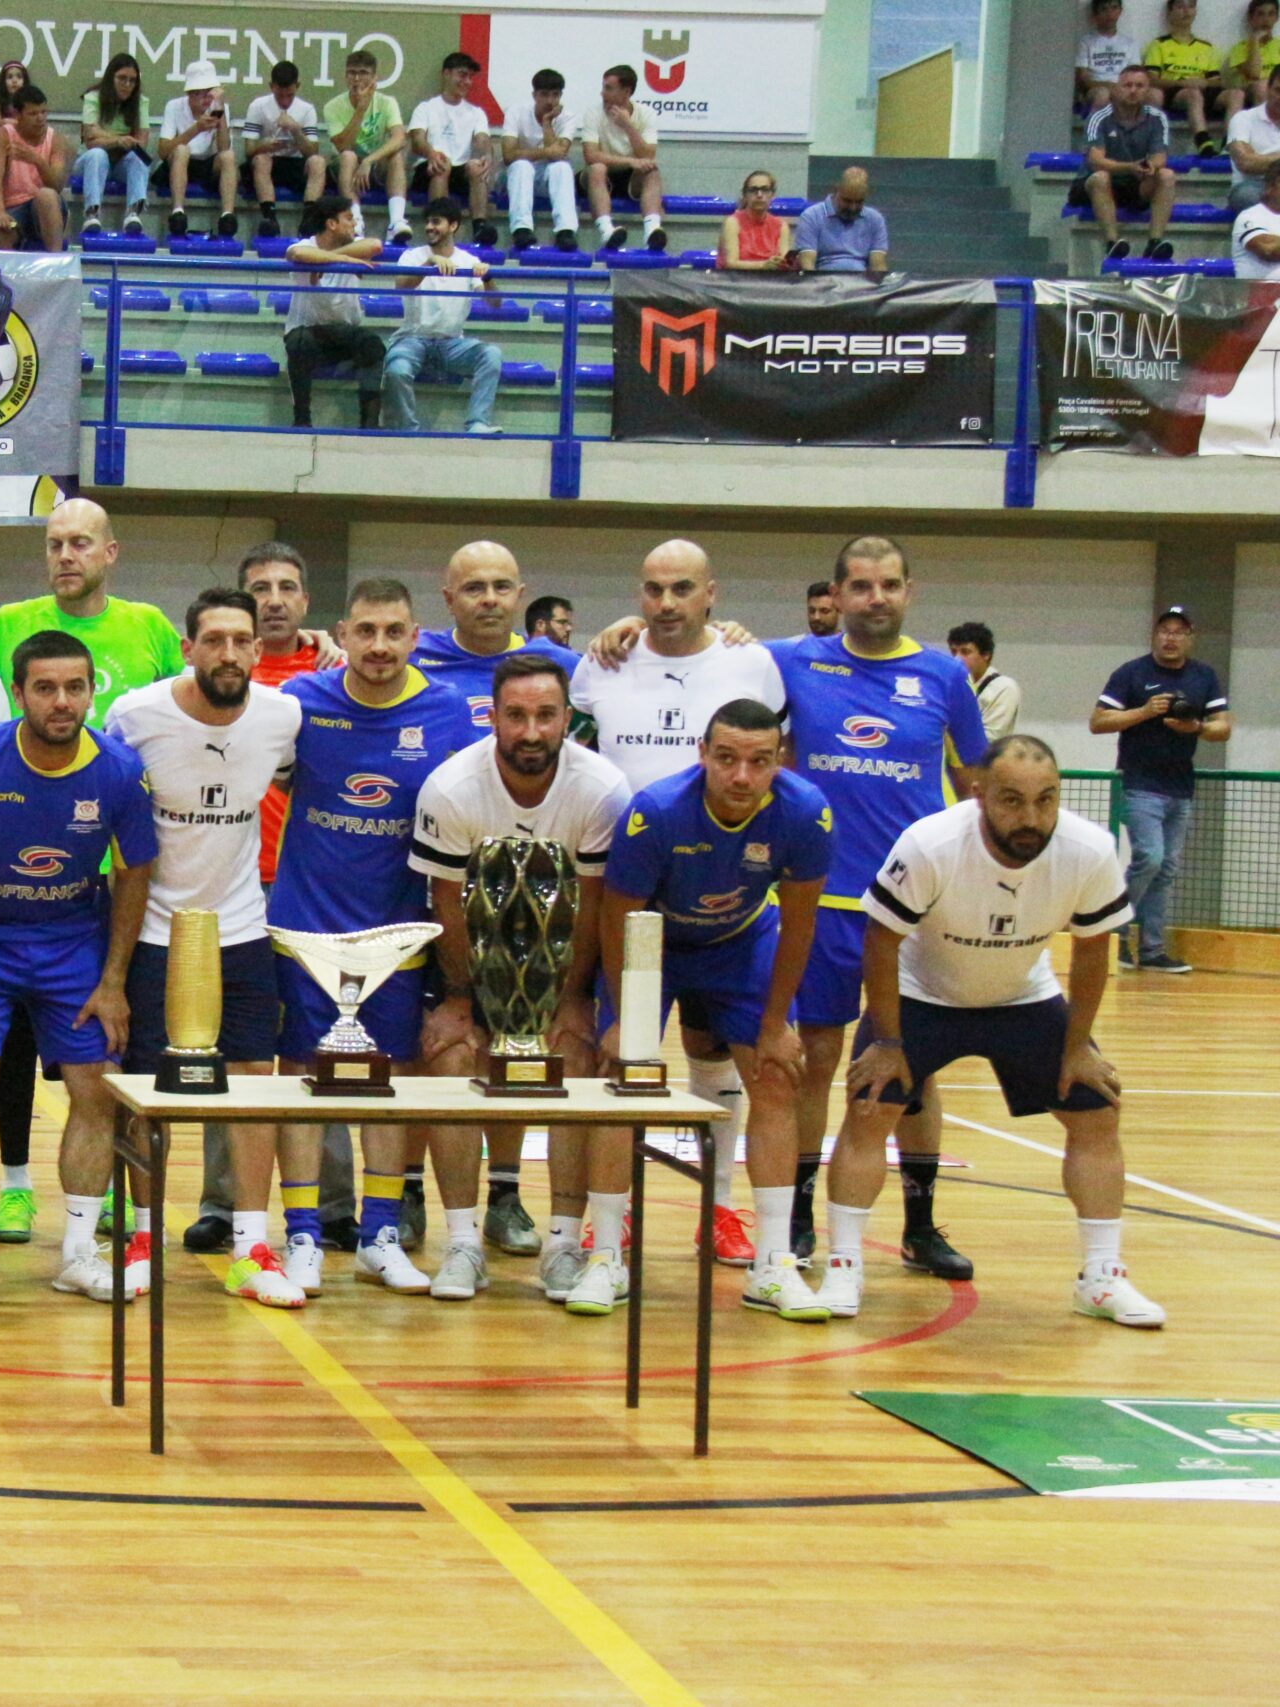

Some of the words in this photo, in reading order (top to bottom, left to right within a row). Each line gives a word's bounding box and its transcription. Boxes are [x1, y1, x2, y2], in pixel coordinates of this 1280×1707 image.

[1062, 285, 1182, 379] TRIBUNA
[724, 335, 968, 356] MAREIOS
[764, 361, 926, 374] MOTORS
[10, 354, 33, 407] BRAGANÇA
[309, 714, 353, 731] macron
[616, 732, 702, 747] restaura
[807, 753, 922, 783] SOFRANÇA
